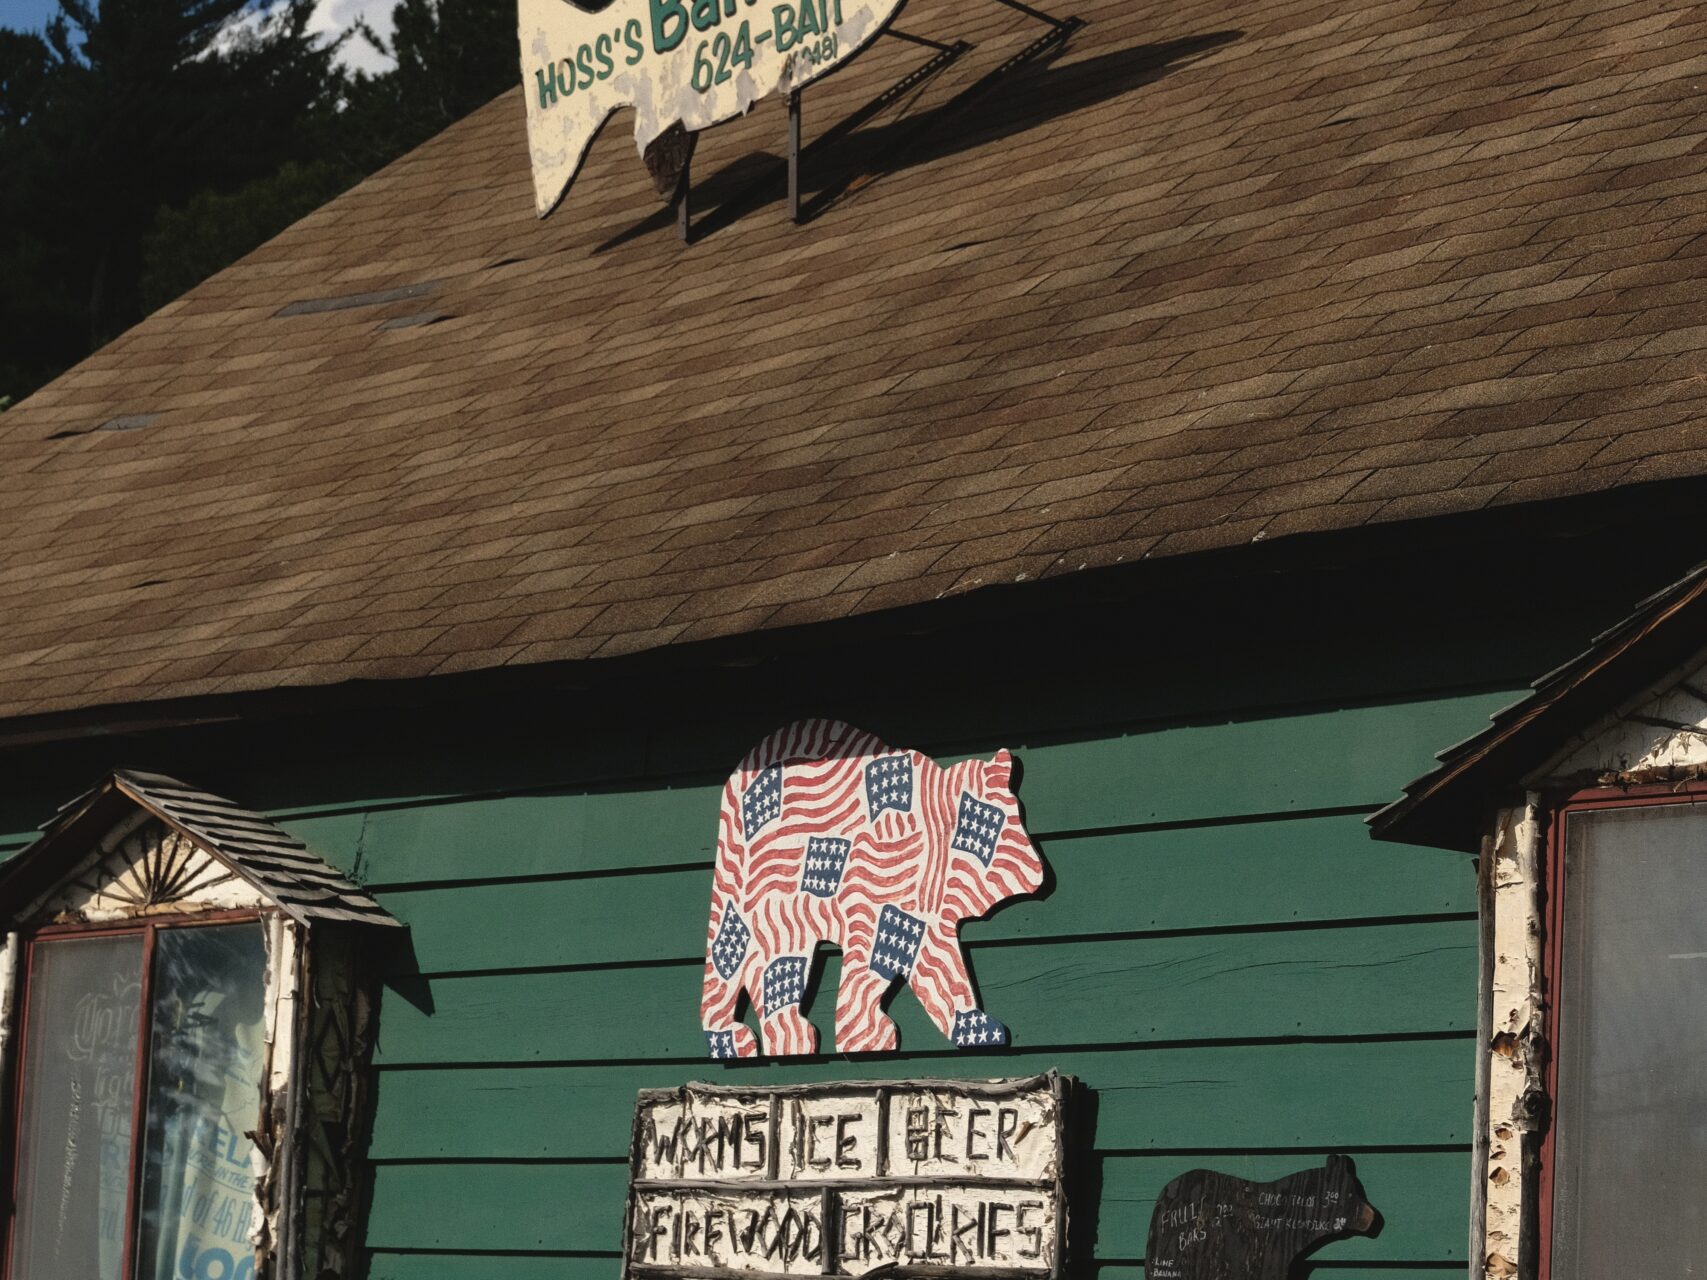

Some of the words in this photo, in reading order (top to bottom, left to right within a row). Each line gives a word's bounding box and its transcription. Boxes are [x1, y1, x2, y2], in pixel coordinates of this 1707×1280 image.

[536, 18, 645, 110] HOSS'S
[651, 1111, 768, 1174] WORMS
[791, 1105, 863, 1171] ICE
[906, 1104, 1021, 1167] BEER
[650, 1203, 823, 1262] FIREWOOD
